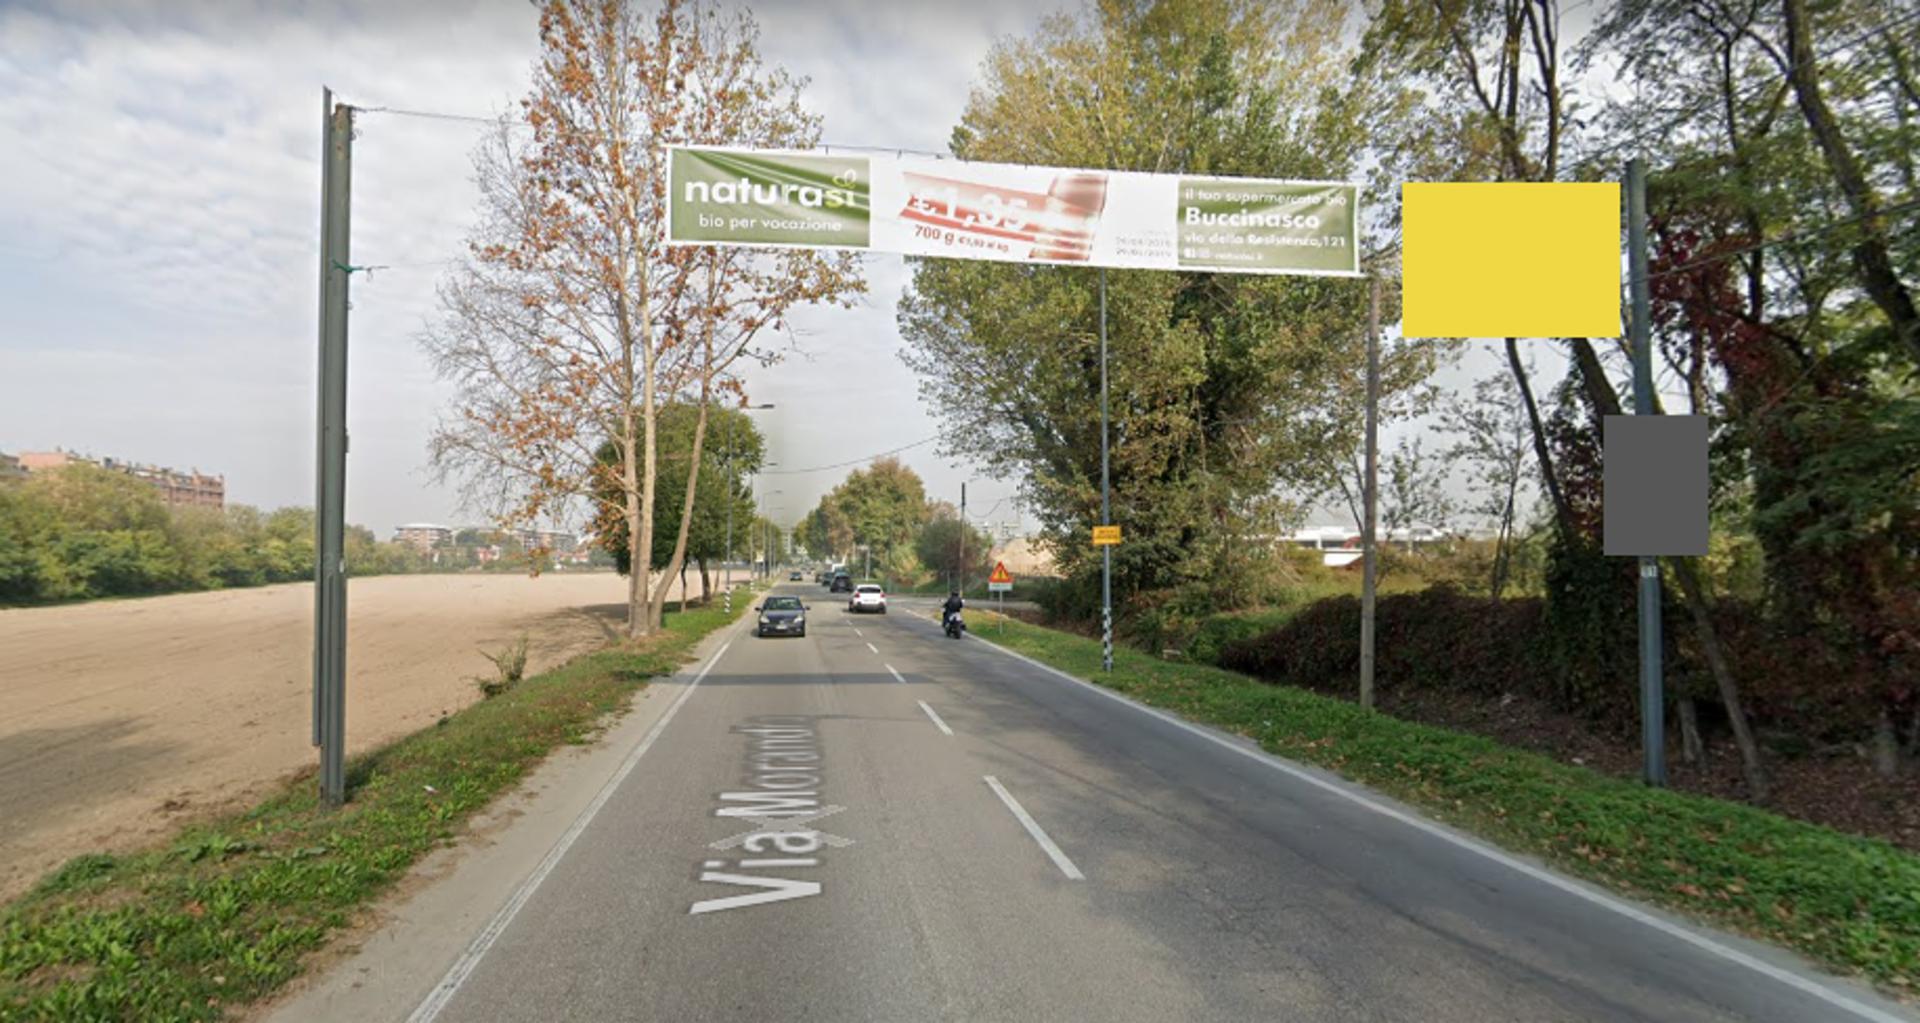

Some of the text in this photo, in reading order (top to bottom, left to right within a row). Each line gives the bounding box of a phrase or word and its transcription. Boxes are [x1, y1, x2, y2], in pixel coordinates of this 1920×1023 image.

[1185, 187, 1194, 200] il
[1198, 189, 1222, 202] tuo
[1225, 189, 1321, 205] supermercato
[699, 213, 842, 232] bio per vocazione
[1185, 206, 1319, 229] Buccinasco
[914, 223, 942, 240] 700
[945, 232, 955, 245] g
[1209, 232, 1243, 245] della
